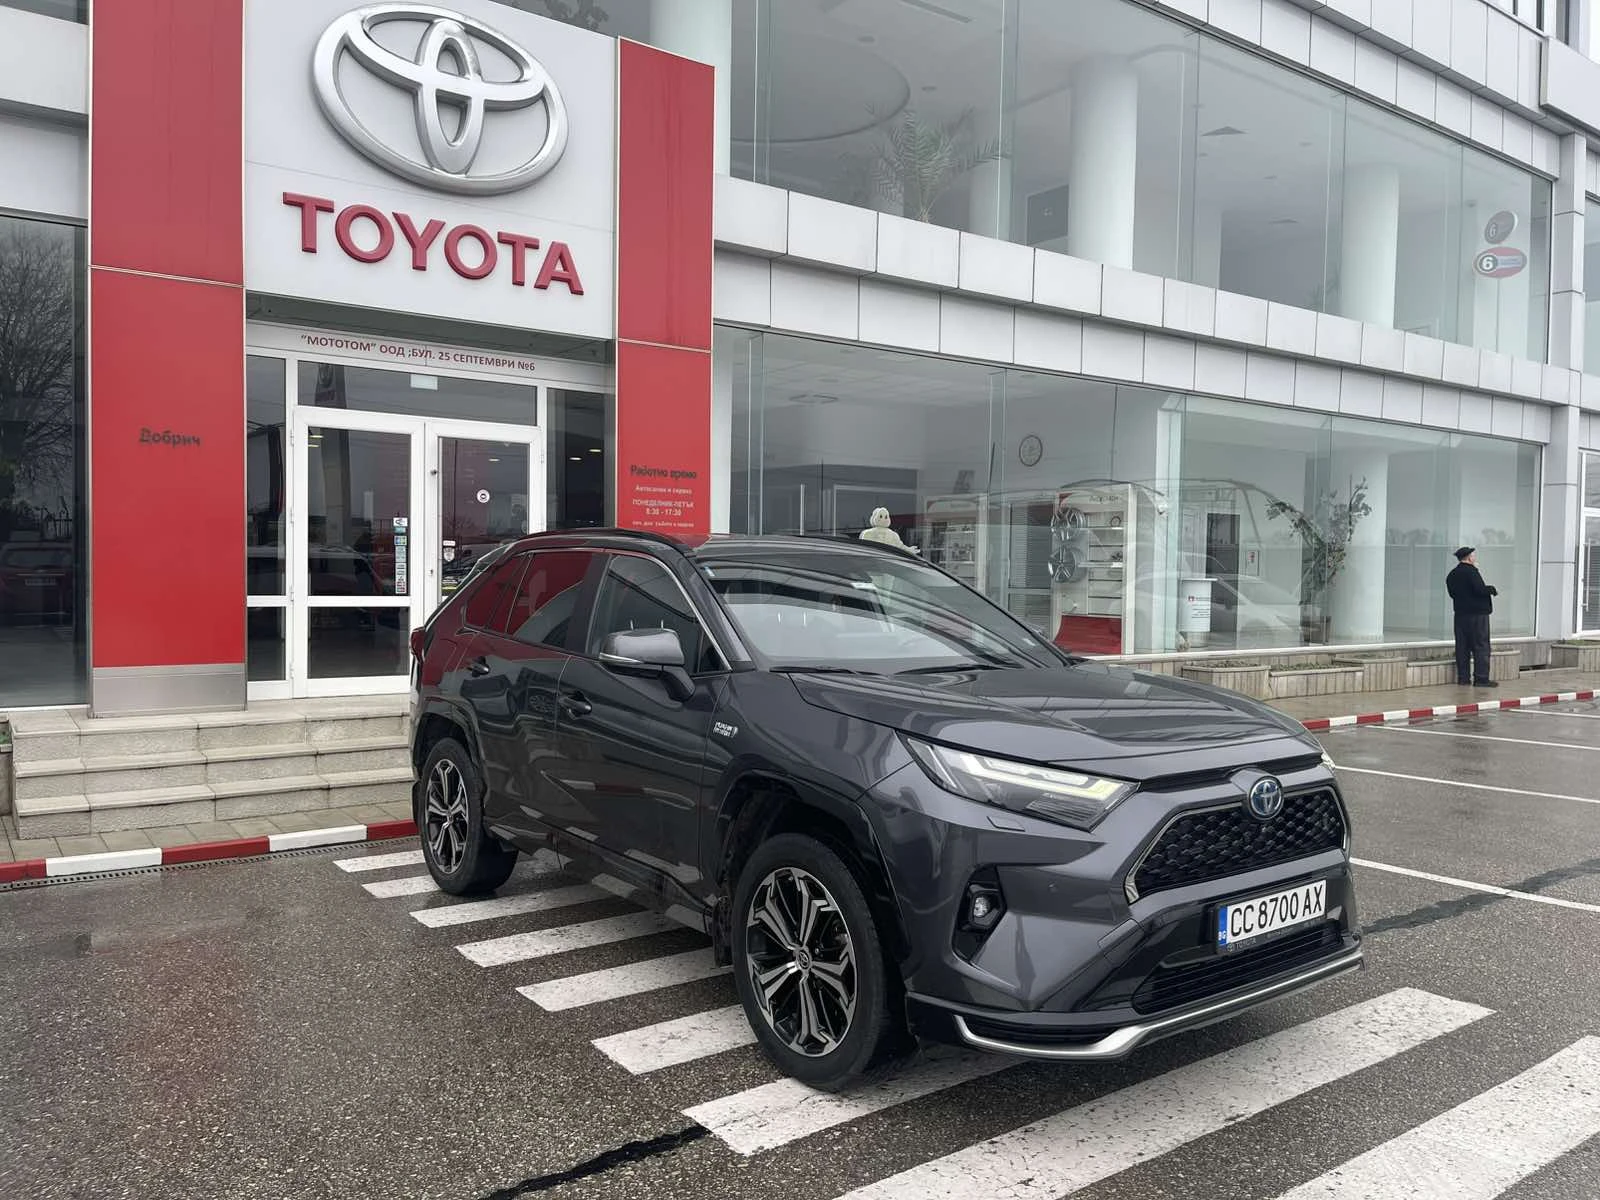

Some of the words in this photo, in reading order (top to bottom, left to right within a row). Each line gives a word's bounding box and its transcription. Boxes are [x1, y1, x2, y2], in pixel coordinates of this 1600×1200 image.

[283, 191, 584, 296] TOYOTA
[1482, 256, 1494, 270] 6
[380, 344, 405, 357] ООД
[438, 351, 450, 361] 25
[453, 353, 515, 369] СЕПТЕМВРИ
[518, 361, 535, 371] №6
[139, 427, 201, 448] Добрич
[1231, 904, 1254, 937] CC
[1258, 892, 1299, 929] 8700
[1303, 885, 1323, 916] AX
